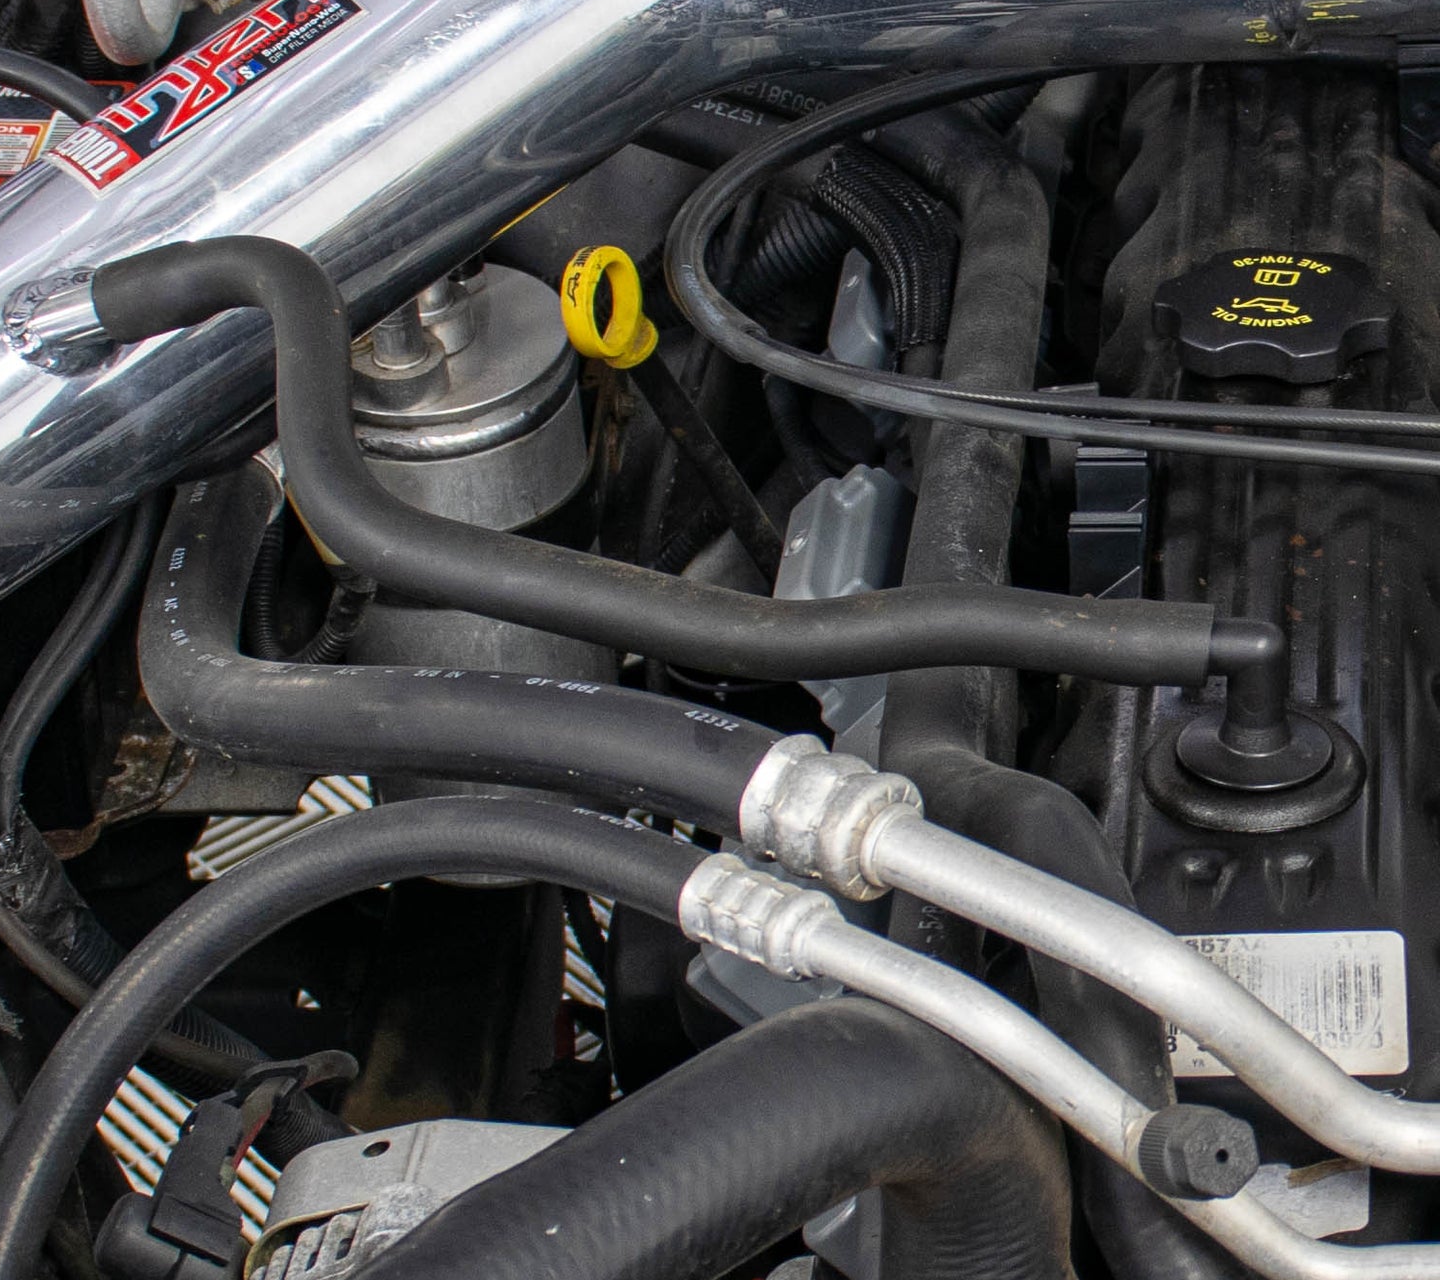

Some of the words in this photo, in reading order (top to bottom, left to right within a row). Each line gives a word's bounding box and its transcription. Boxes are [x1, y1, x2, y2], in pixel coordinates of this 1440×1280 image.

[262, 2, 341, 57] SuperNano-Web
[268, 45, 288, 64] DRY
[287, 26, 318, 56] FILTER
[318, 8, 348, 37] MEDIA
[1233, 255, 1294, 267] 10W-30
[1297, 258, 1332, 274] SAE
[1211, 307, 1238, 322] OIL
[1238, 314, 1313, 327] ENGINE
